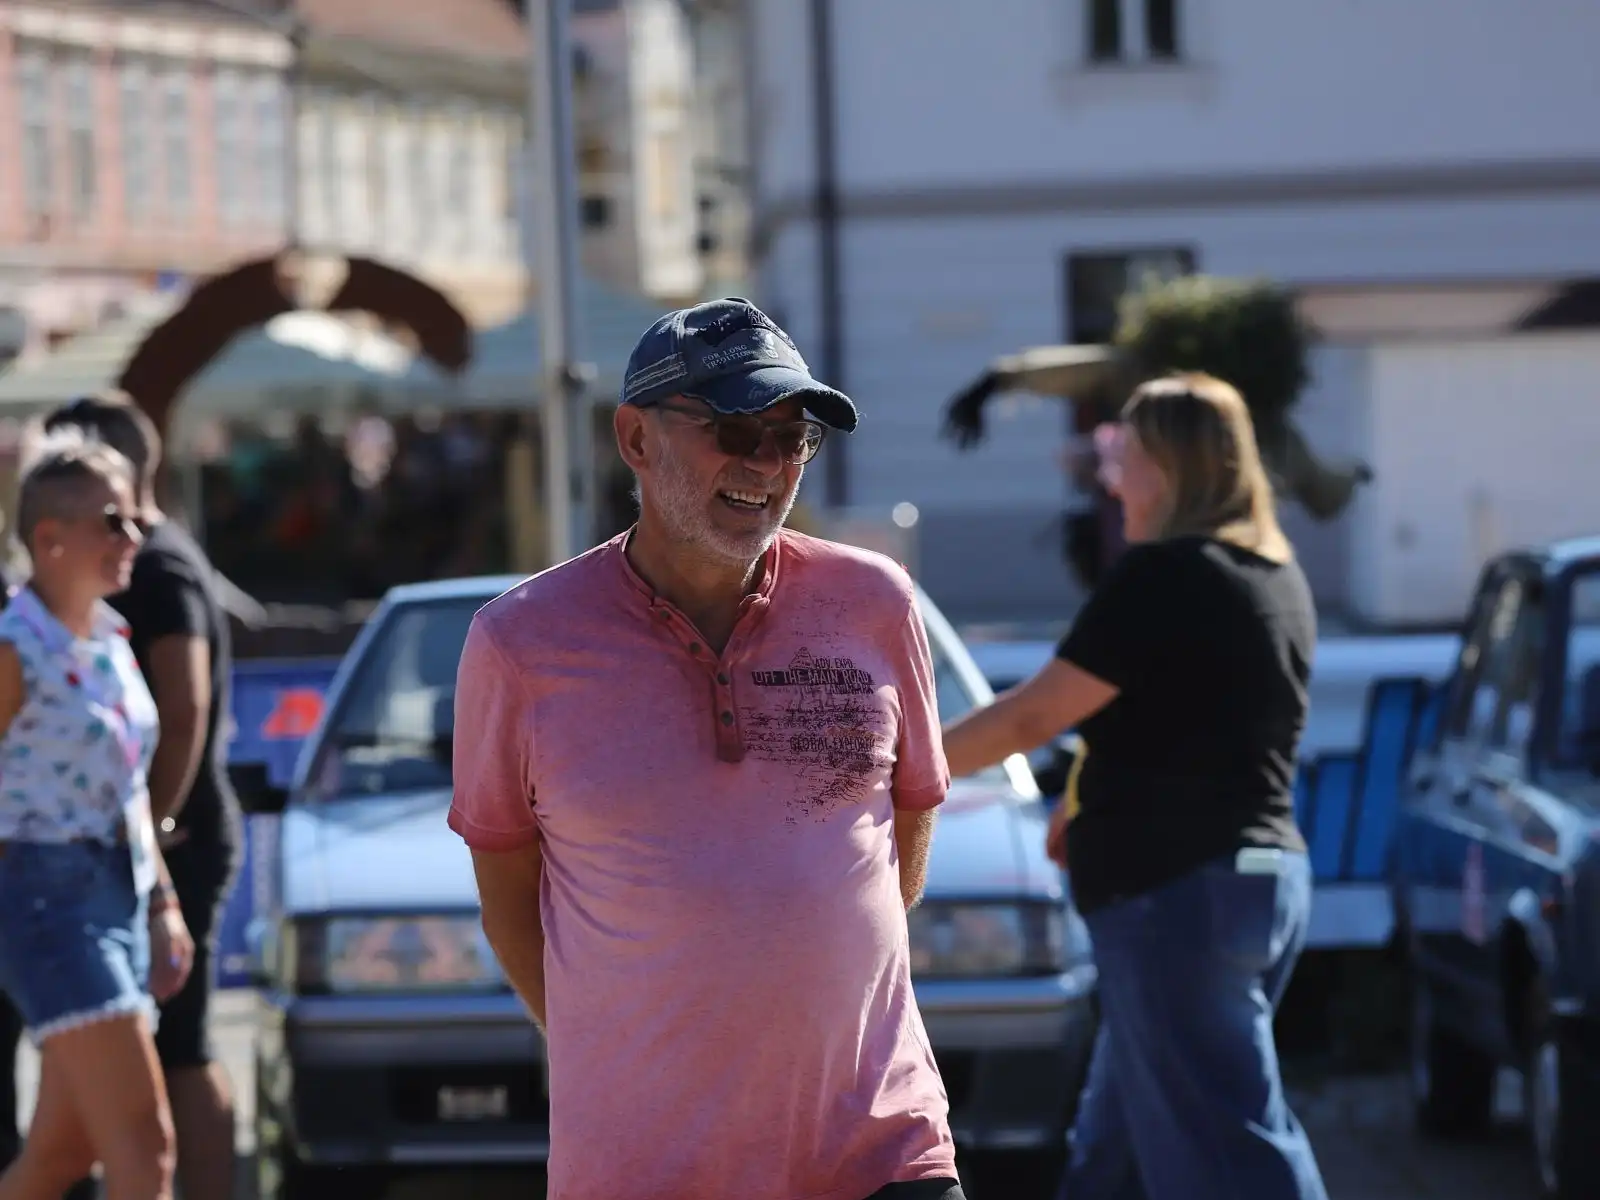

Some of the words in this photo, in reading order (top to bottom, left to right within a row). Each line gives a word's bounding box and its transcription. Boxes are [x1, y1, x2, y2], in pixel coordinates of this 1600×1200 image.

[702, 352, 721, 364] FOR
[723, 345, 748, 356] LONG
[783, 670, 807, 684] THE
[808, 669, 839, 684] MAIN
[843, 670, 870, 684] ROAD
